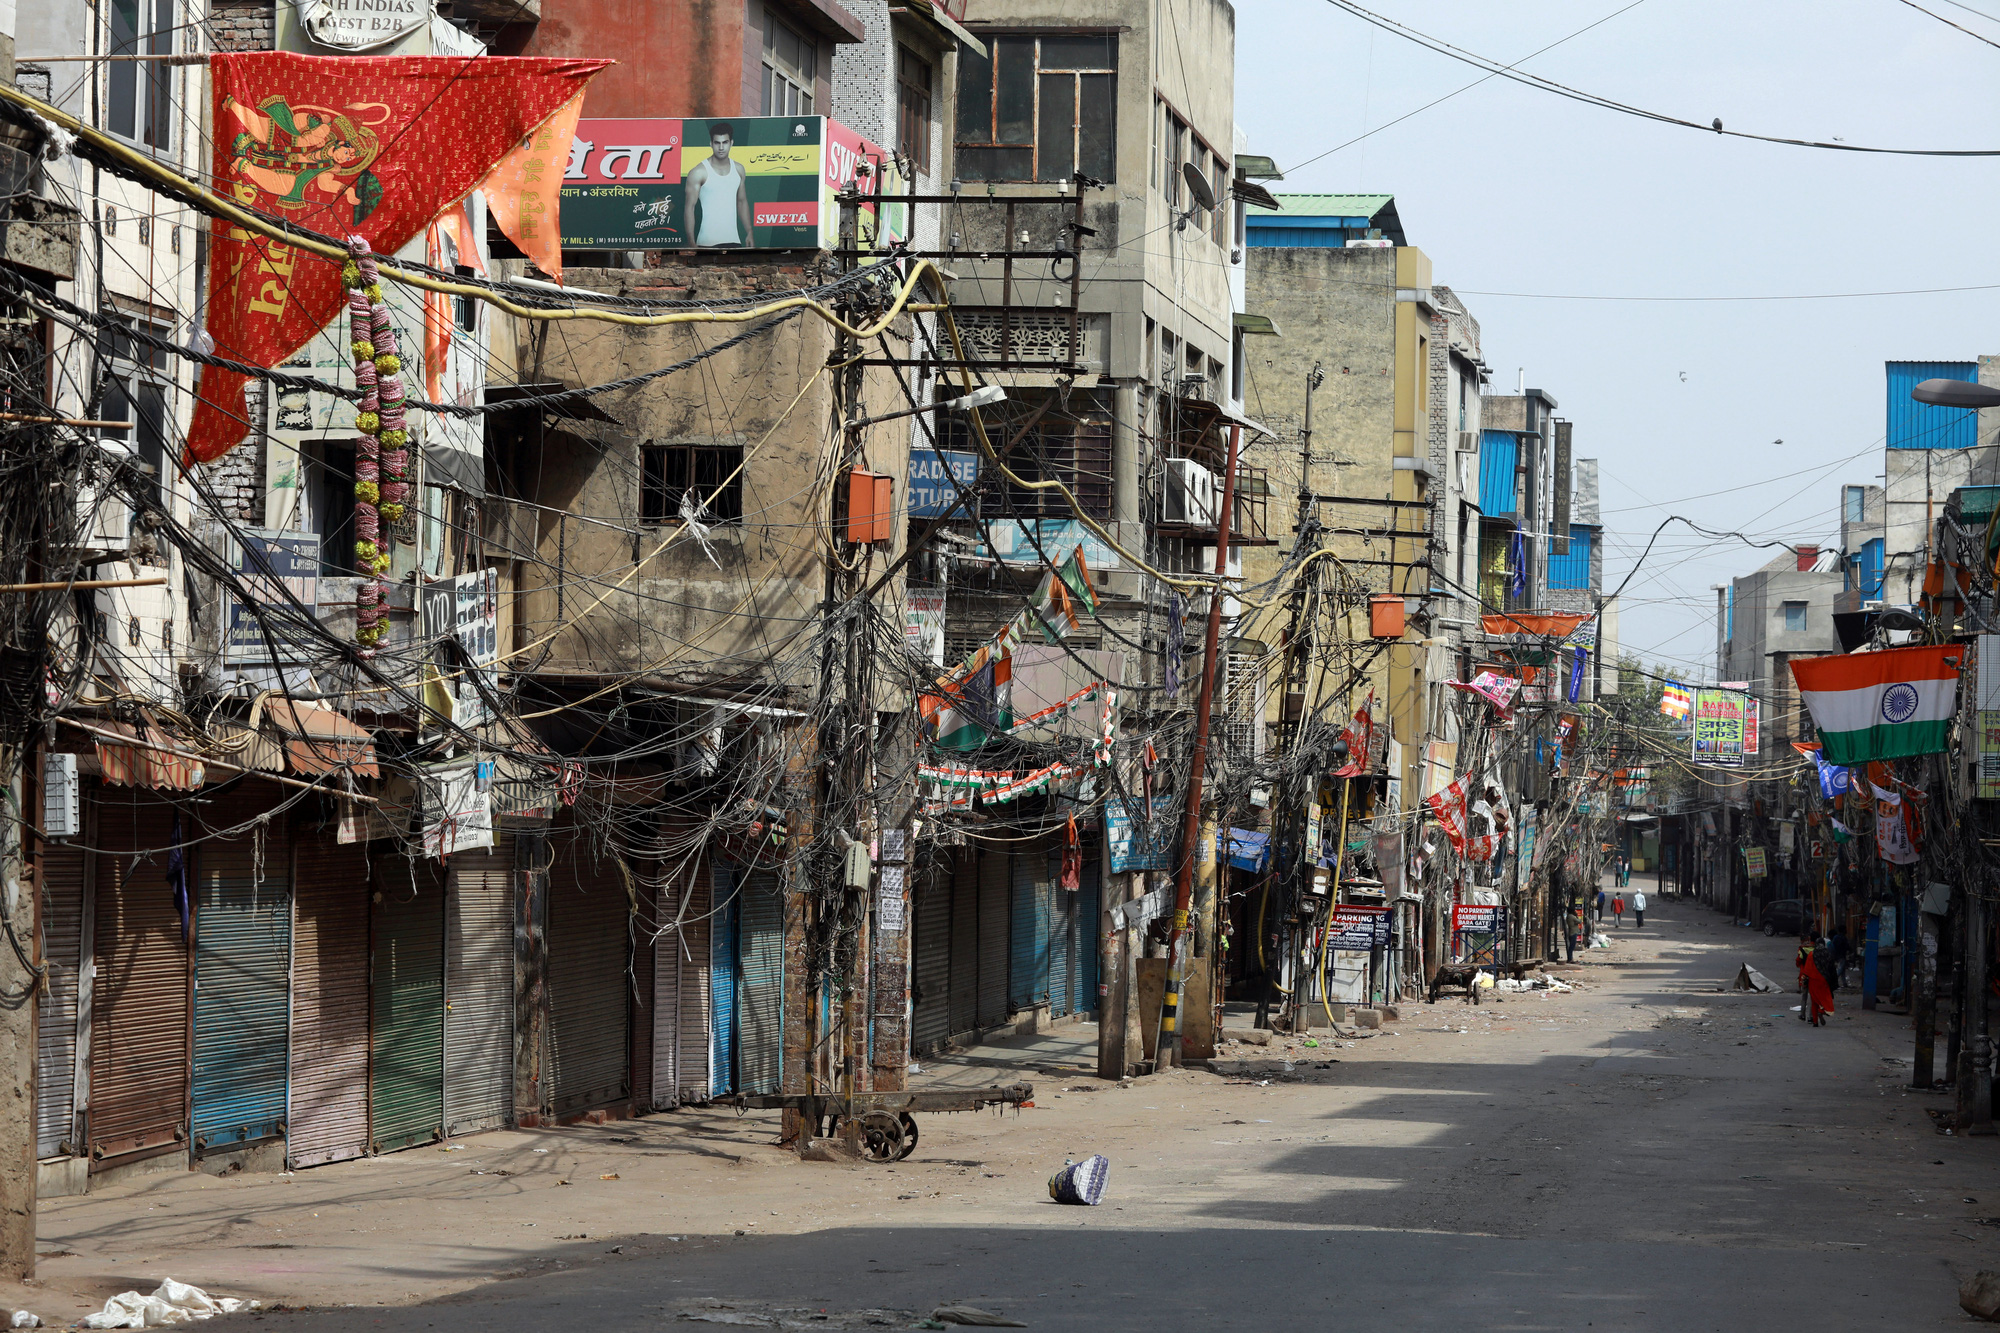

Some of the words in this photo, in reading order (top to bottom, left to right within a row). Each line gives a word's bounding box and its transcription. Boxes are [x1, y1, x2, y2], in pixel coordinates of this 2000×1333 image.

[371, 18, 403, 31] B2B
[589, 185, 639, 197] अंडरवियर
[756, 212, 808, 224] SWETA
[1702, 701, 1738, 710] RAHUL
[1698, 710, 1742, 719] ENTERPRISES
[1336, 913, 1373, 923] PARKING
